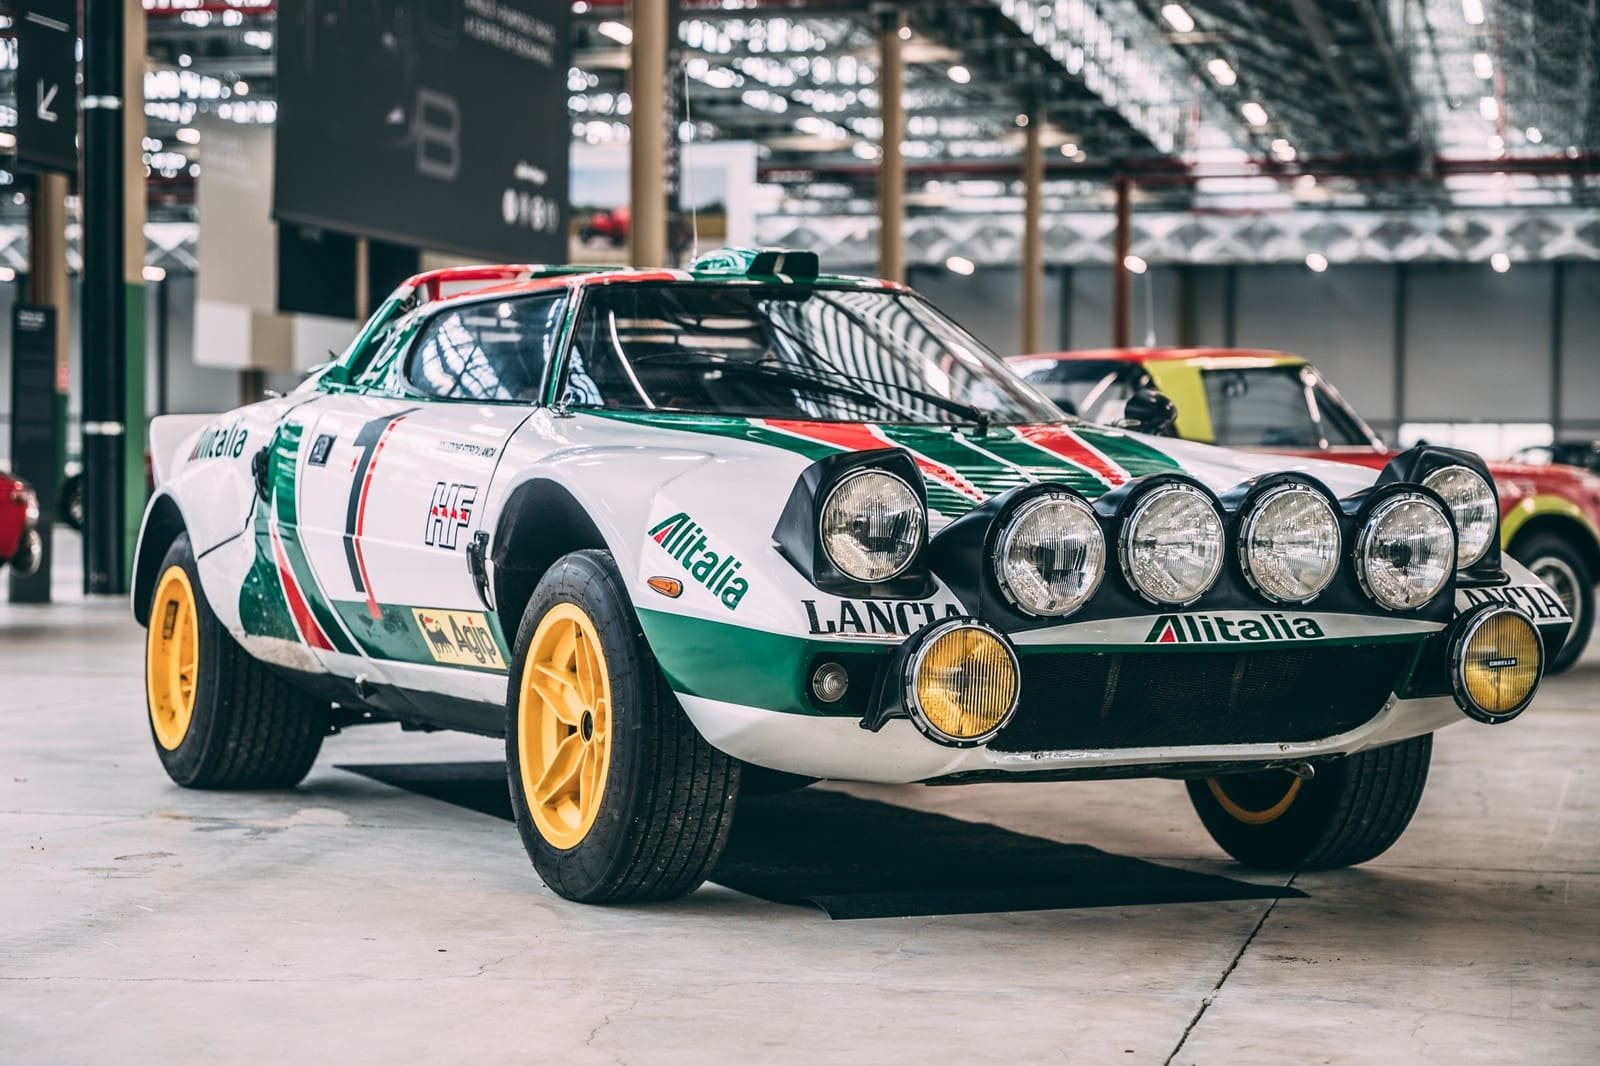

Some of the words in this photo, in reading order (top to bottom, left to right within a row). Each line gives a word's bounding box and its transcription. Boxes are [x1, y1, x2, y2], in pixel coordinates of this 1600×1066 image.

[424, 481, 478, 552] HF
[647, 511, 749, 611] Alitalia
[447, 614, 498, 665] Agip
[1144, 613, 1326, 643] Alitalia
